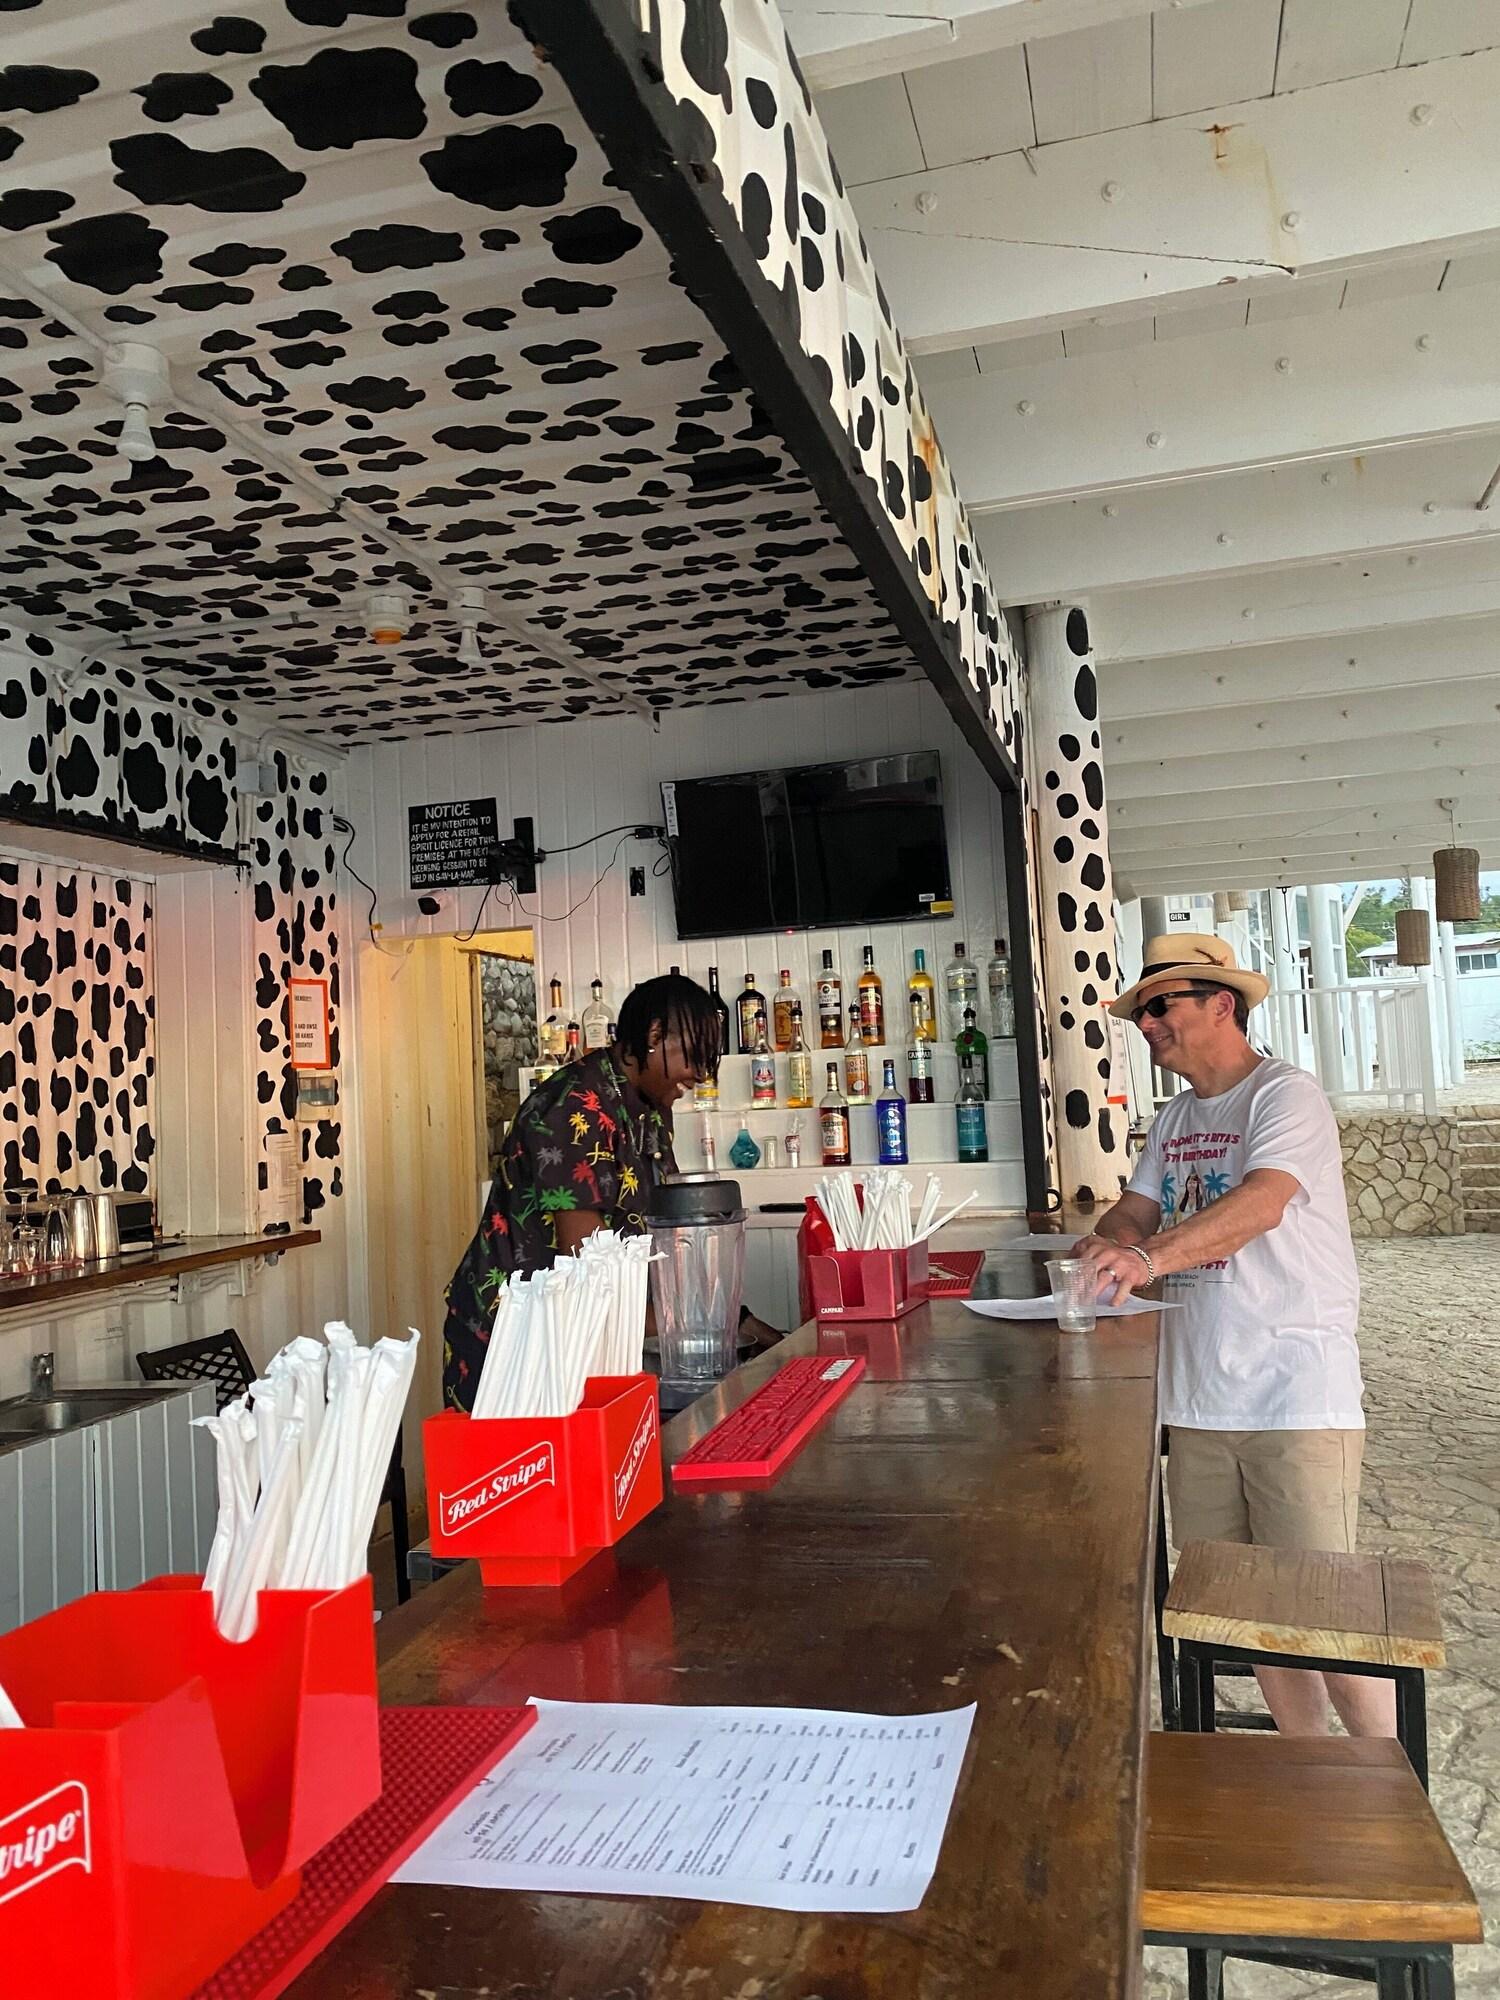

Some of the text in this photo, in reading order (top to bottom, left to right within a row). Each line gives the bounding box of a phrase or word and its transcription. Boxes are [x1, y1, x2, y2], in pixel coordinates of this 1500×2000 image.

[425, 803, 471, 820] NOTICE
[412, 824, 420, 833] IT
[422, 823, 429, 832] IS
[442, 818, 478, 829] INTENTION
[480, 816, 491, 825] TO
[411, 833, 434, 842] APPLY
[436, 831, 449, 839] FOR
[458, 827, 480, 837] RETAIL
[411, 835, 496, 852] SPIRIT LICENCE FOR THIS
[411, 847, 488, 863] PREMISES AT THE NEXT
[411, 858, 487, 874] LICENSING SESSION TO BE
[411, 873, 427, 883] HELD
[427, 873, 435, 881] IN
[1171, 913, 1187, 921] GIRL
[1210, 1133, 1240, 1144] RITA'S
[1182, 1147, 1227, 1161] BIRTHDAY!
[618, 1409, 654, 1507] Red Stripe
[447, 1456, 549, 1525] Red Stripe
